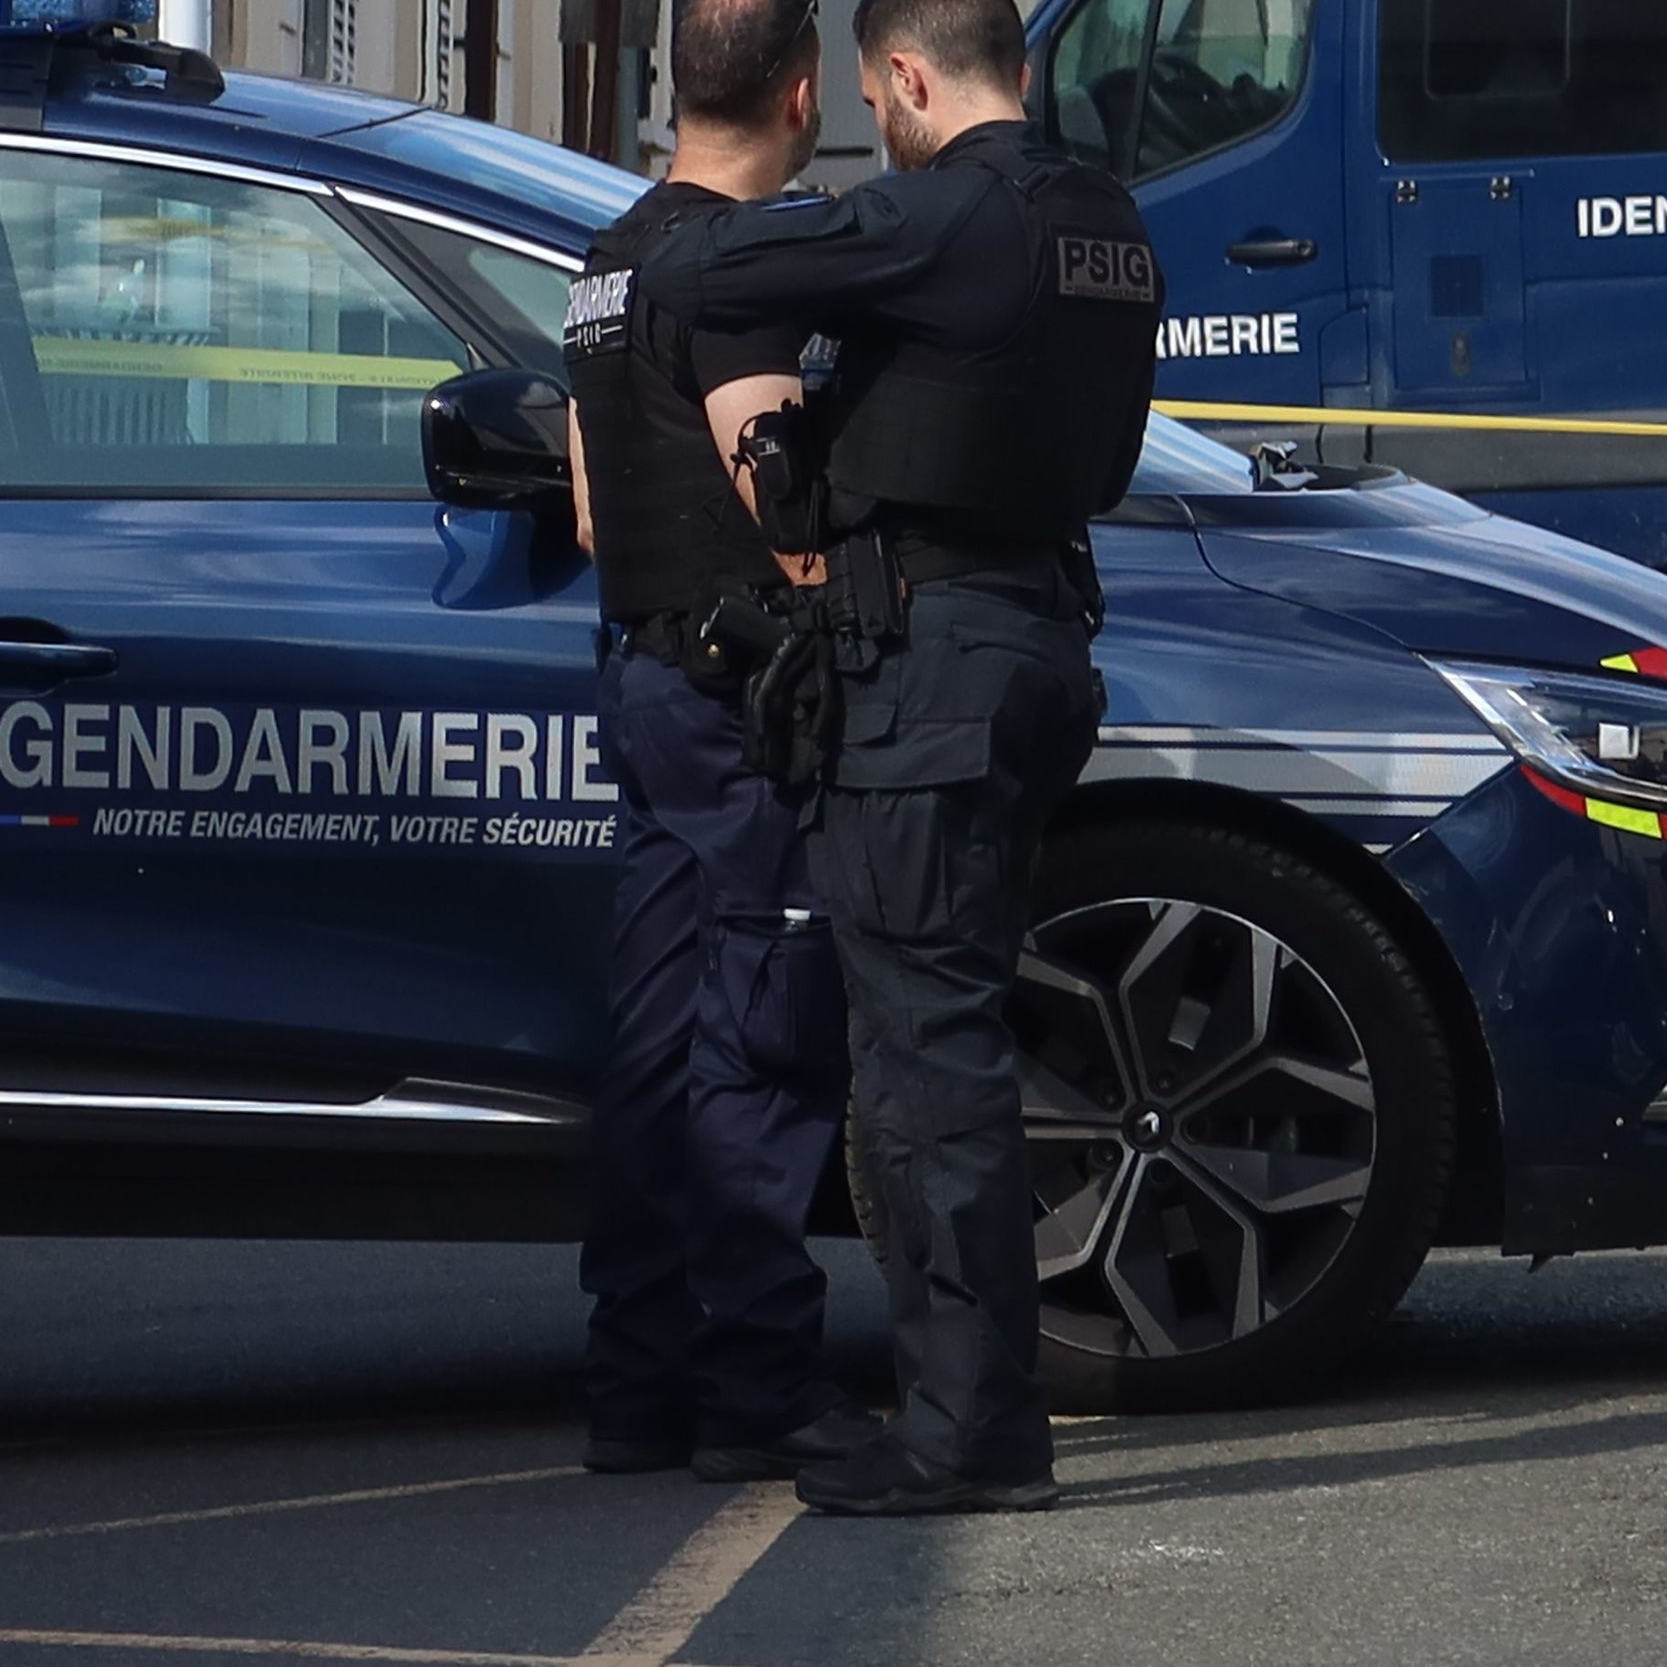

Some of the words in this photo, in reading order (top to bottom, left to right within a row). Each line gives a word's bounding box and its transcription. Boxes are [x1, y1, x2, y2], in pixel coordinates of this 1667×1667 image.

[1064, 240, 1151, 289] PSIG
[577, 322, 601, 348] PSIG
[0, 700, 620, 802] GENDARMERIE
[92, 808, 186, 837] NOTRE
[189, 810, 380, 847] ENGAGEMENT,
[390, 814, 479, 844] VOTRE
[482, 811, 617, 847] SÉCURITÉ
